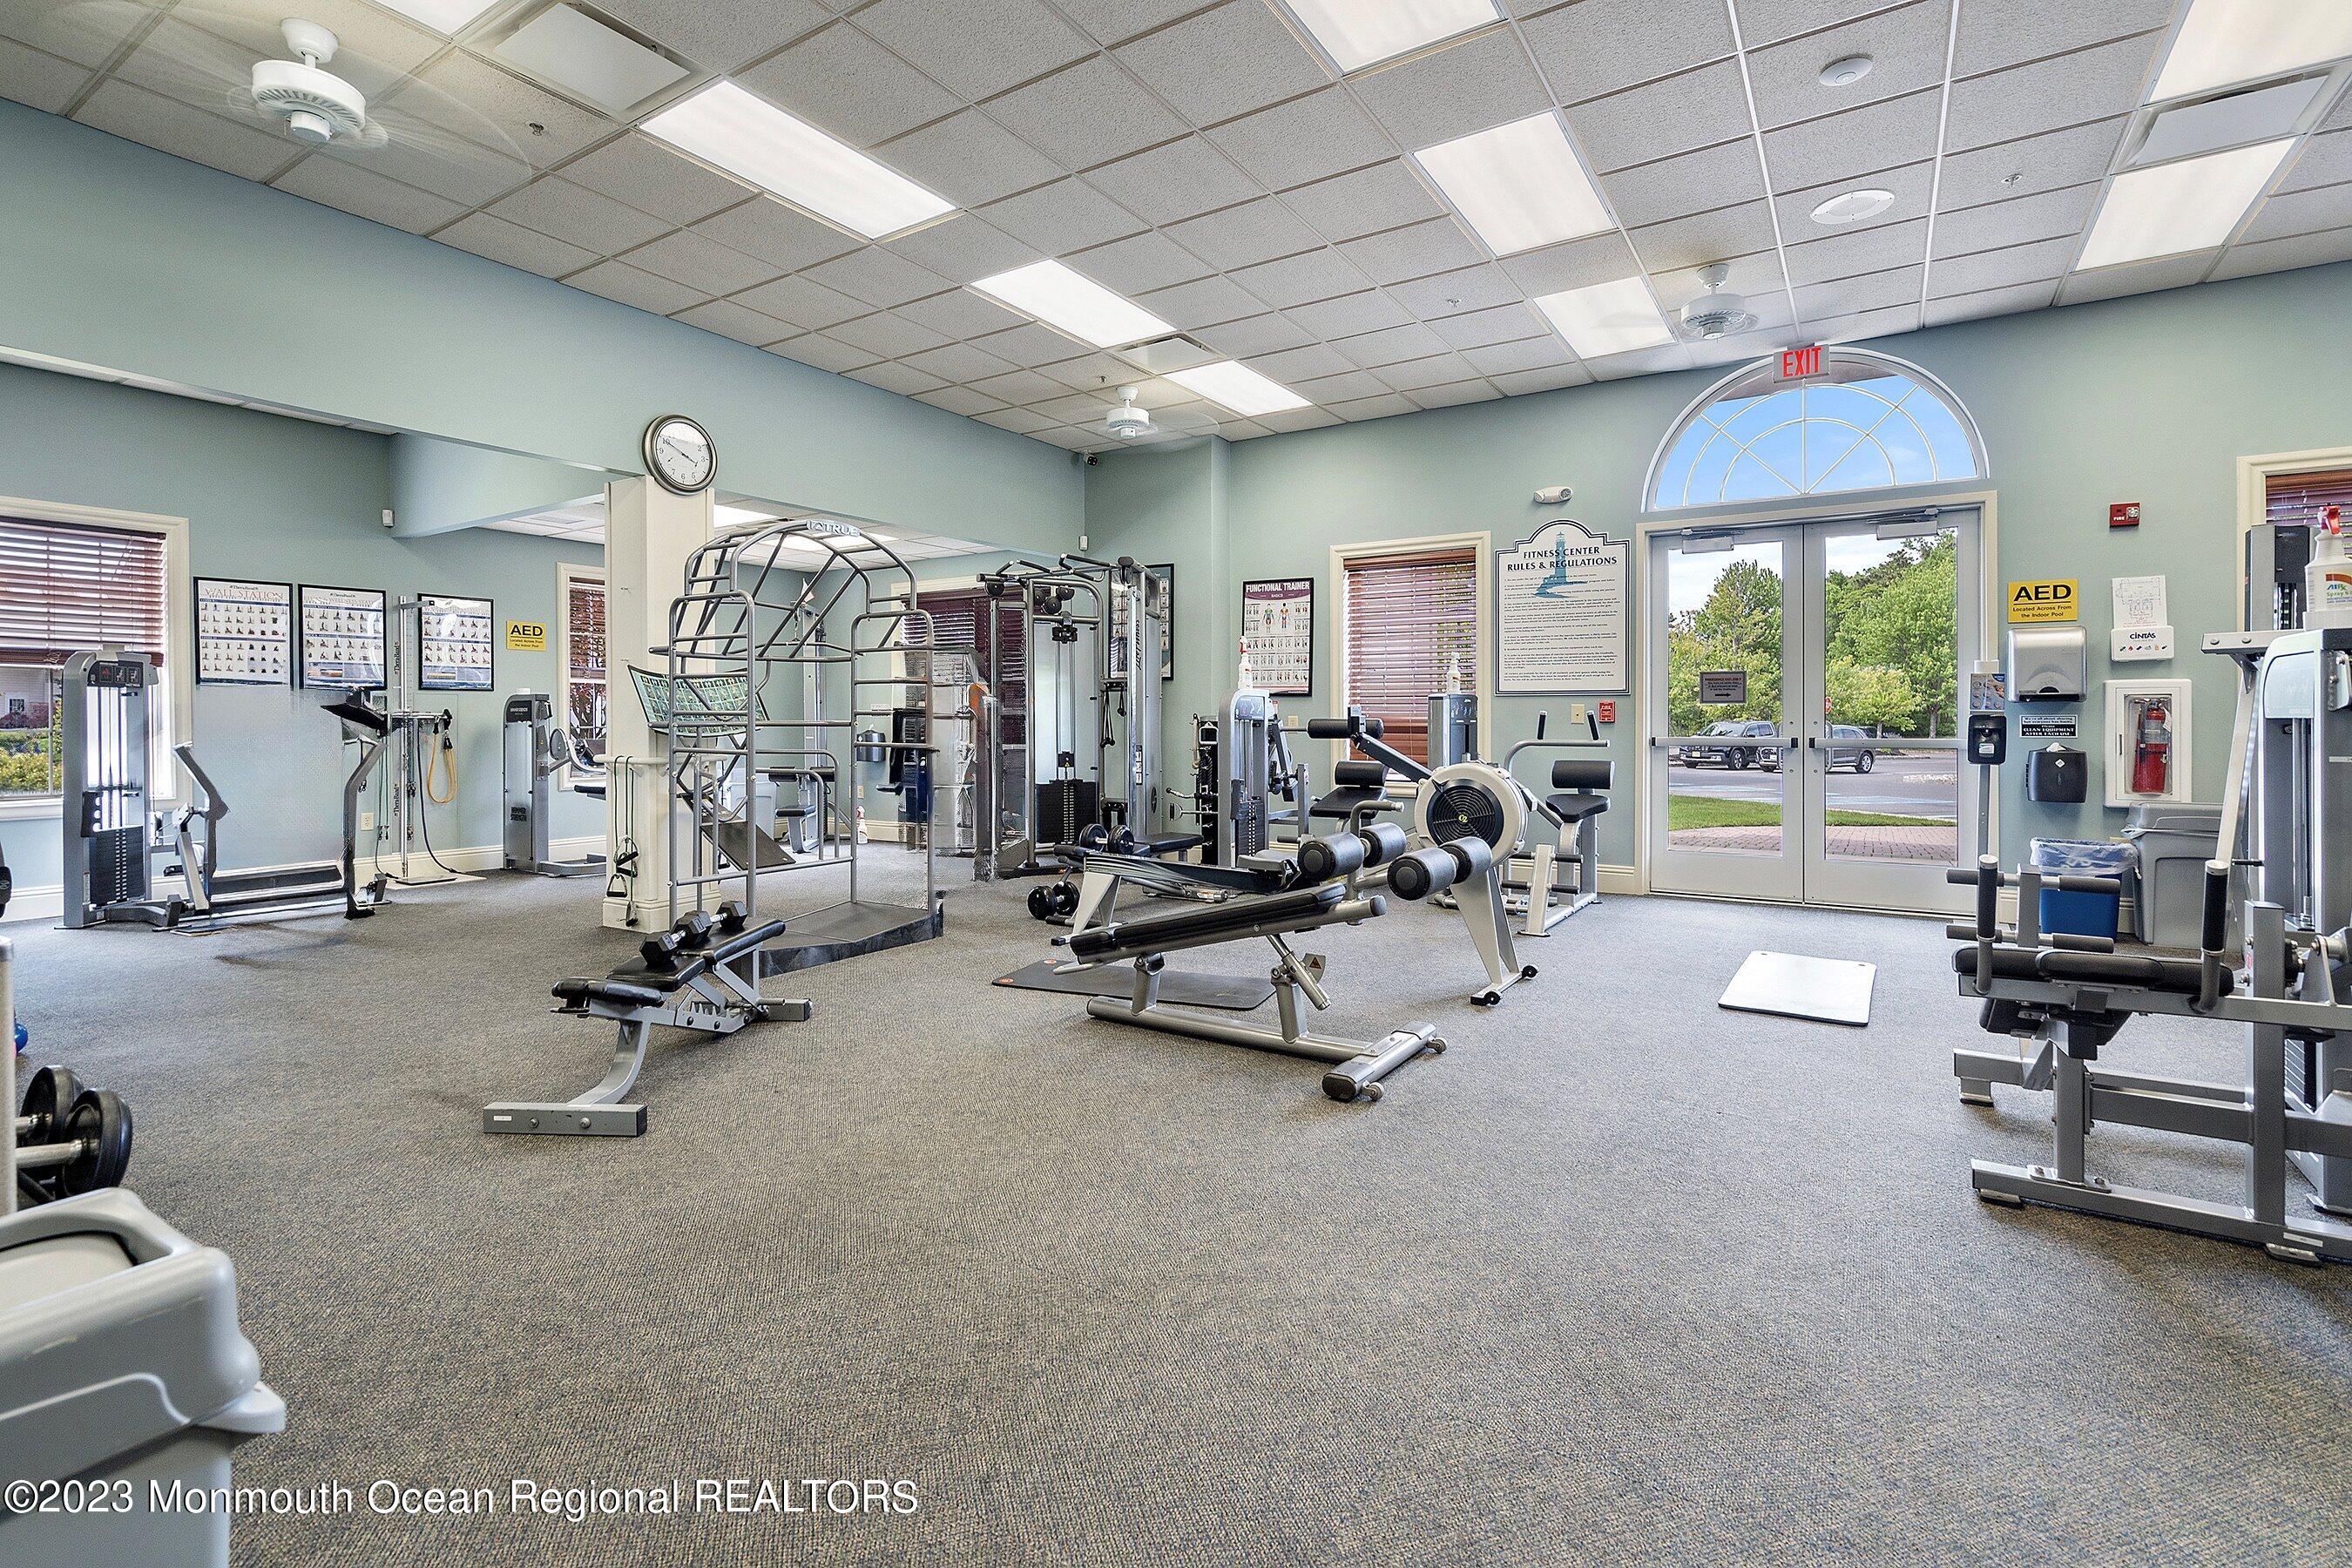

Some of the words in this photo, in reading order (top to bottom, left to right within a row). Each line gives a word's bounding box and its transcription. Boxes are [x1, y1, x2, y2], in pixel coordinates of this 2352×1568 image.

[1783, 347, 1822, 377] EXIT
[1524, 549, 1560, 558] FITNESS
[1563, 546, 1600, 556] CENTER
[1507, 562, 1536, 571] RULES
[1550, 557, 1618, 569] REGULATIONS
[1246, 583, 1282, 592] FUNCTIONAL
[1283, 581, 1310, 591] TRAINER
[239, 590, 284, 599] STATION
[2013, 584, 2072, 602] AED
[510, 625, 543, 636] AED
